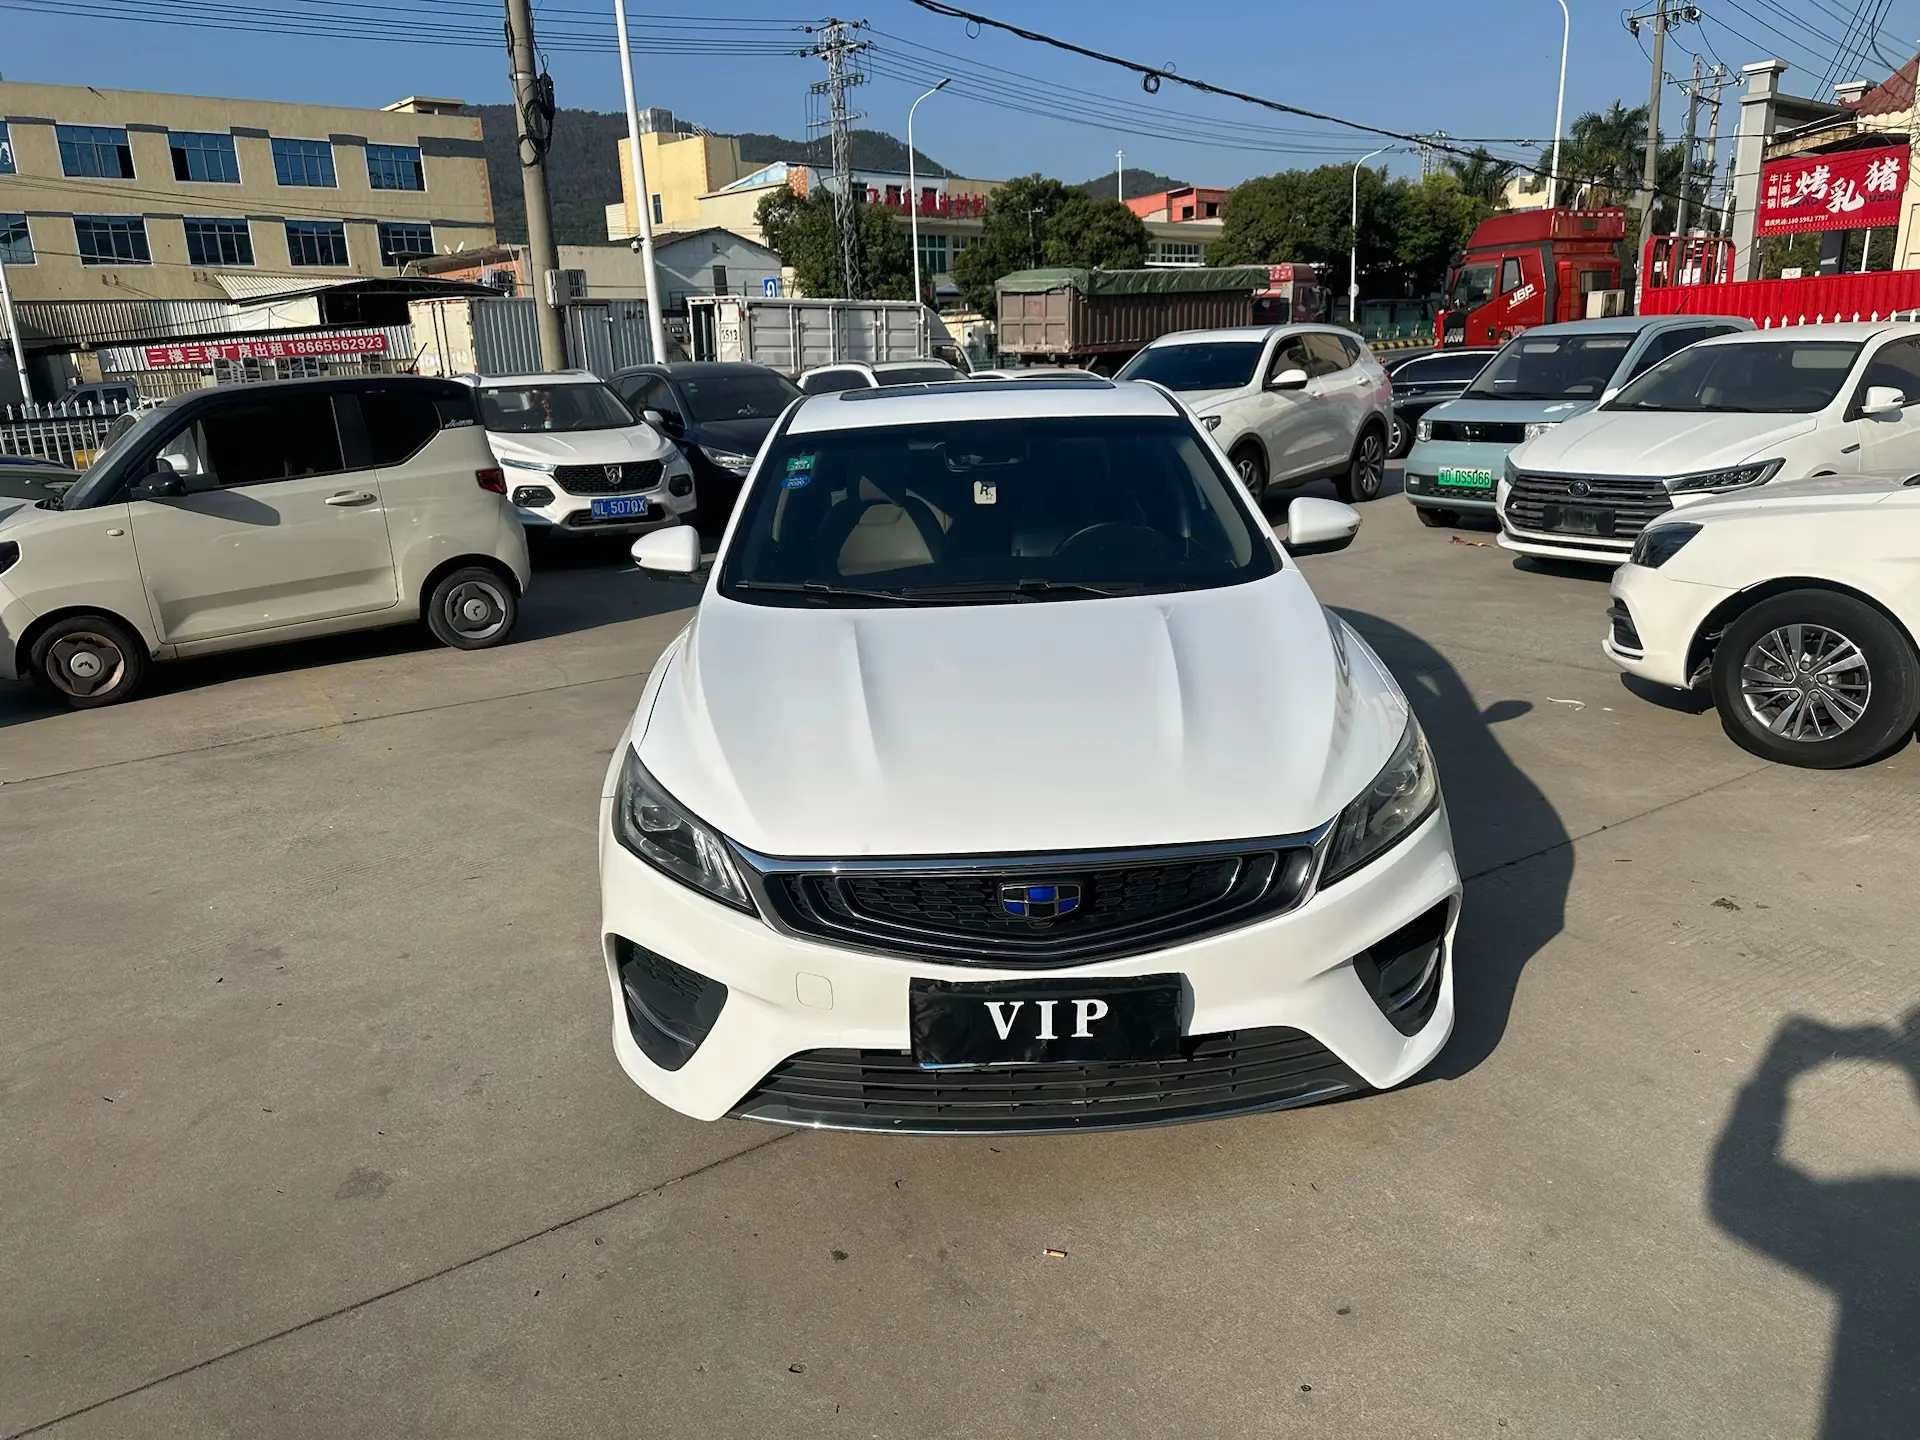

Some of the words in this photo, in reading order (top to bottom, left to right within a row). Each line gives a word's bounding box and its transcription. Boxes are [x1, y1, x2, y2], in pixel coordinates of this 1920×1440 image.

[1785, 157, 1900, 214] 烤乳猪
[1509, 283, 1535, 305] J6P
[150, 342, 285, 363] 二楼三楼厂房出租
[288, 337, 383, 354] 18665562923
[984, 999, 1109, 1040] VIP
